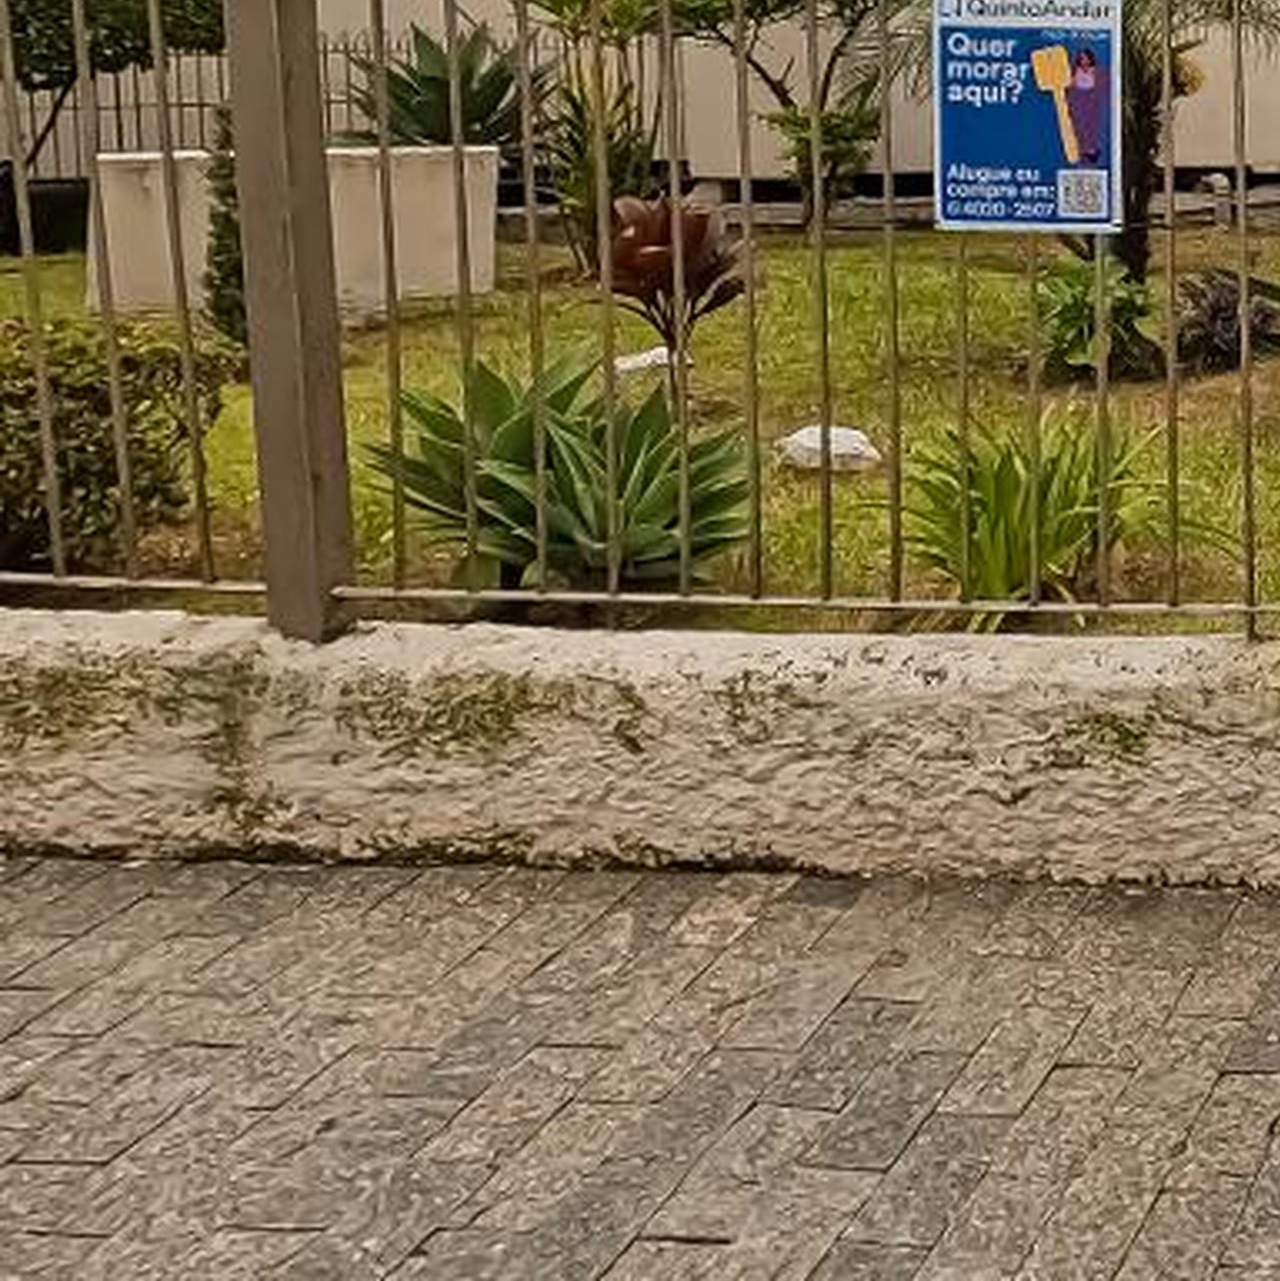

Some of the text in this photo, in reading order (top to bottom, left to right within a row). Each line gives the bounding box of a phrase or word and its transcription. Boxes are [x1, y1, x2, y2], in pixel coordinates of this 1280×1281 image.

[947, 32, 1017, 57] Quer
[947, 60, 1030, 80] morar
[947, 79, 1024, 108] aqui?
[946, 183, 1018, 200] compre
